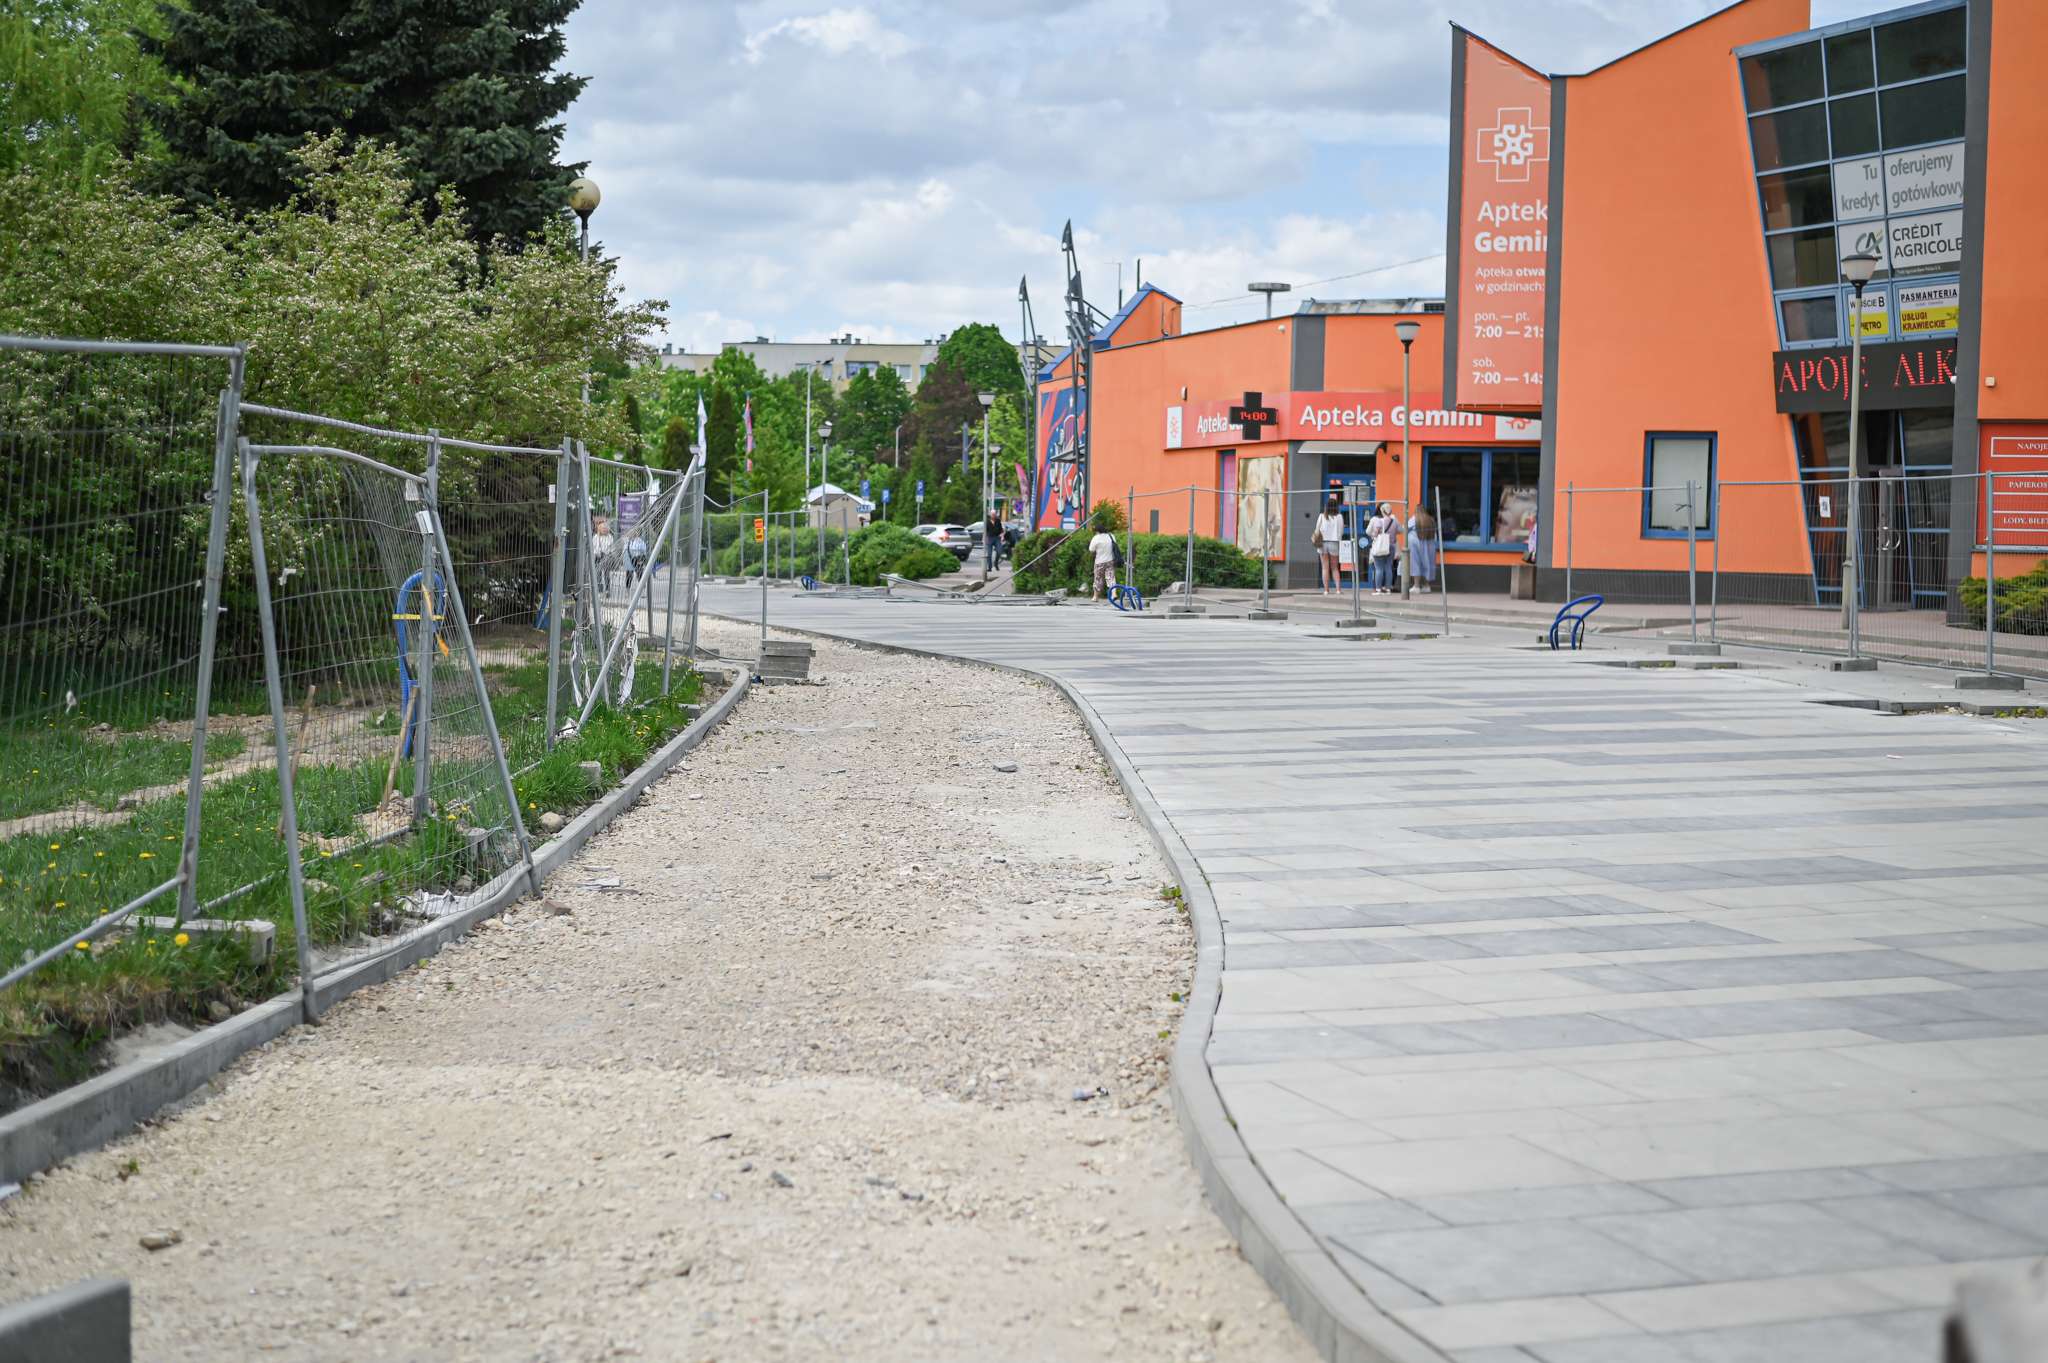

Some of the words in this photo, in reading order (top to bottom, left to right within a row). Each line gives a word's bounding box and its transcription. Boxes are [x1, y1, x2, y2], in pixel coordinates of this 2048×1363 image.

[1863, 164, 1878, 181] Tu
[1890, 154, 1953, 177] oferujemy
[1841, 191, 1880, 212] kredyt
[1892, 180, 1964, 208] gotówkowy
[1477, 199, 1548, 228] Aptek
[1892, 222, 1942, 242] CRÉDIT
[1894, 237, 1962, 259] AGRICOLE
[1475, 267, 1513, 279] Apteka
[1515, 267, 1545, 277] otwa
[1475, 284, 1485, 292] w
[1900, 288, 1958, 303] PASMANTERIA
[1878, 296, 1885, 308] B
[1474, 312, 1499, 323] pon.
[1515, 311, 1530, 322] pt.
[1474, 325, 1503, 338] 7:00
[1902, 319, 1946, 332] KRAWIECKIE
[1472, 357, 1496, 367] sob.
[1472, 371, 1501, 384] 7:00
[1779, 355, 1870, 401] APOJ
[1892, 349, 1957, 387] ALK
[1197, 412, 1228, 438] Apteka
[1300, 405, 1383, 432] Apteka
[1391, 405, 1483, 427] Gemini
